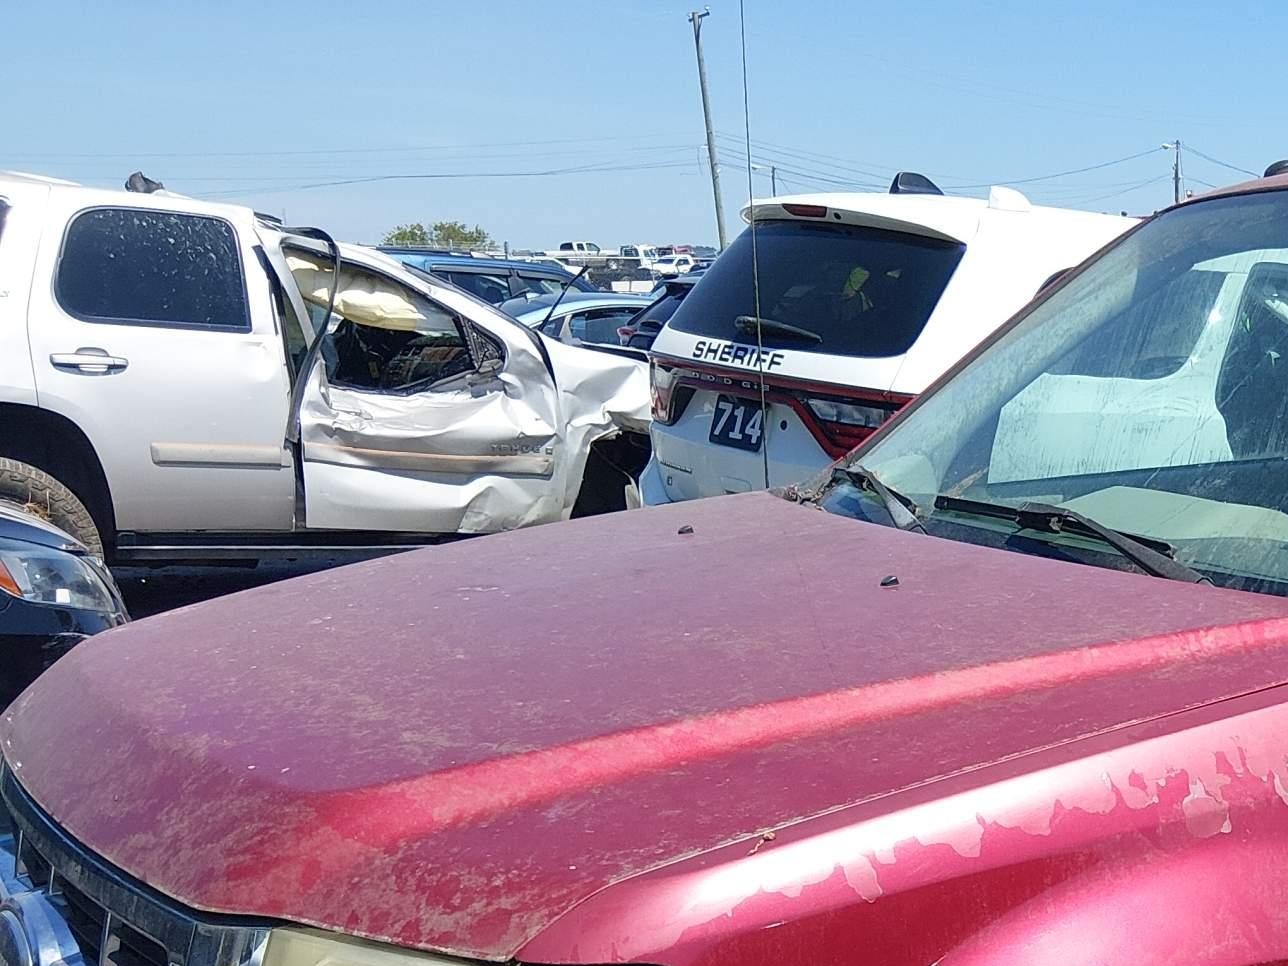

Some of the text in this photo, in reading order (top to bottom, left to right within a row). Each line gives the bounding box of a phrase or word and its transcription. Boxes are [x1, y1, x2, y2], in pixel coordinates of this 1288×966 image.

[692, 340, 785, 371] SHERIFF
[691, 371, 770, 392] DODGE
[713, 401, 763, 444] 714
